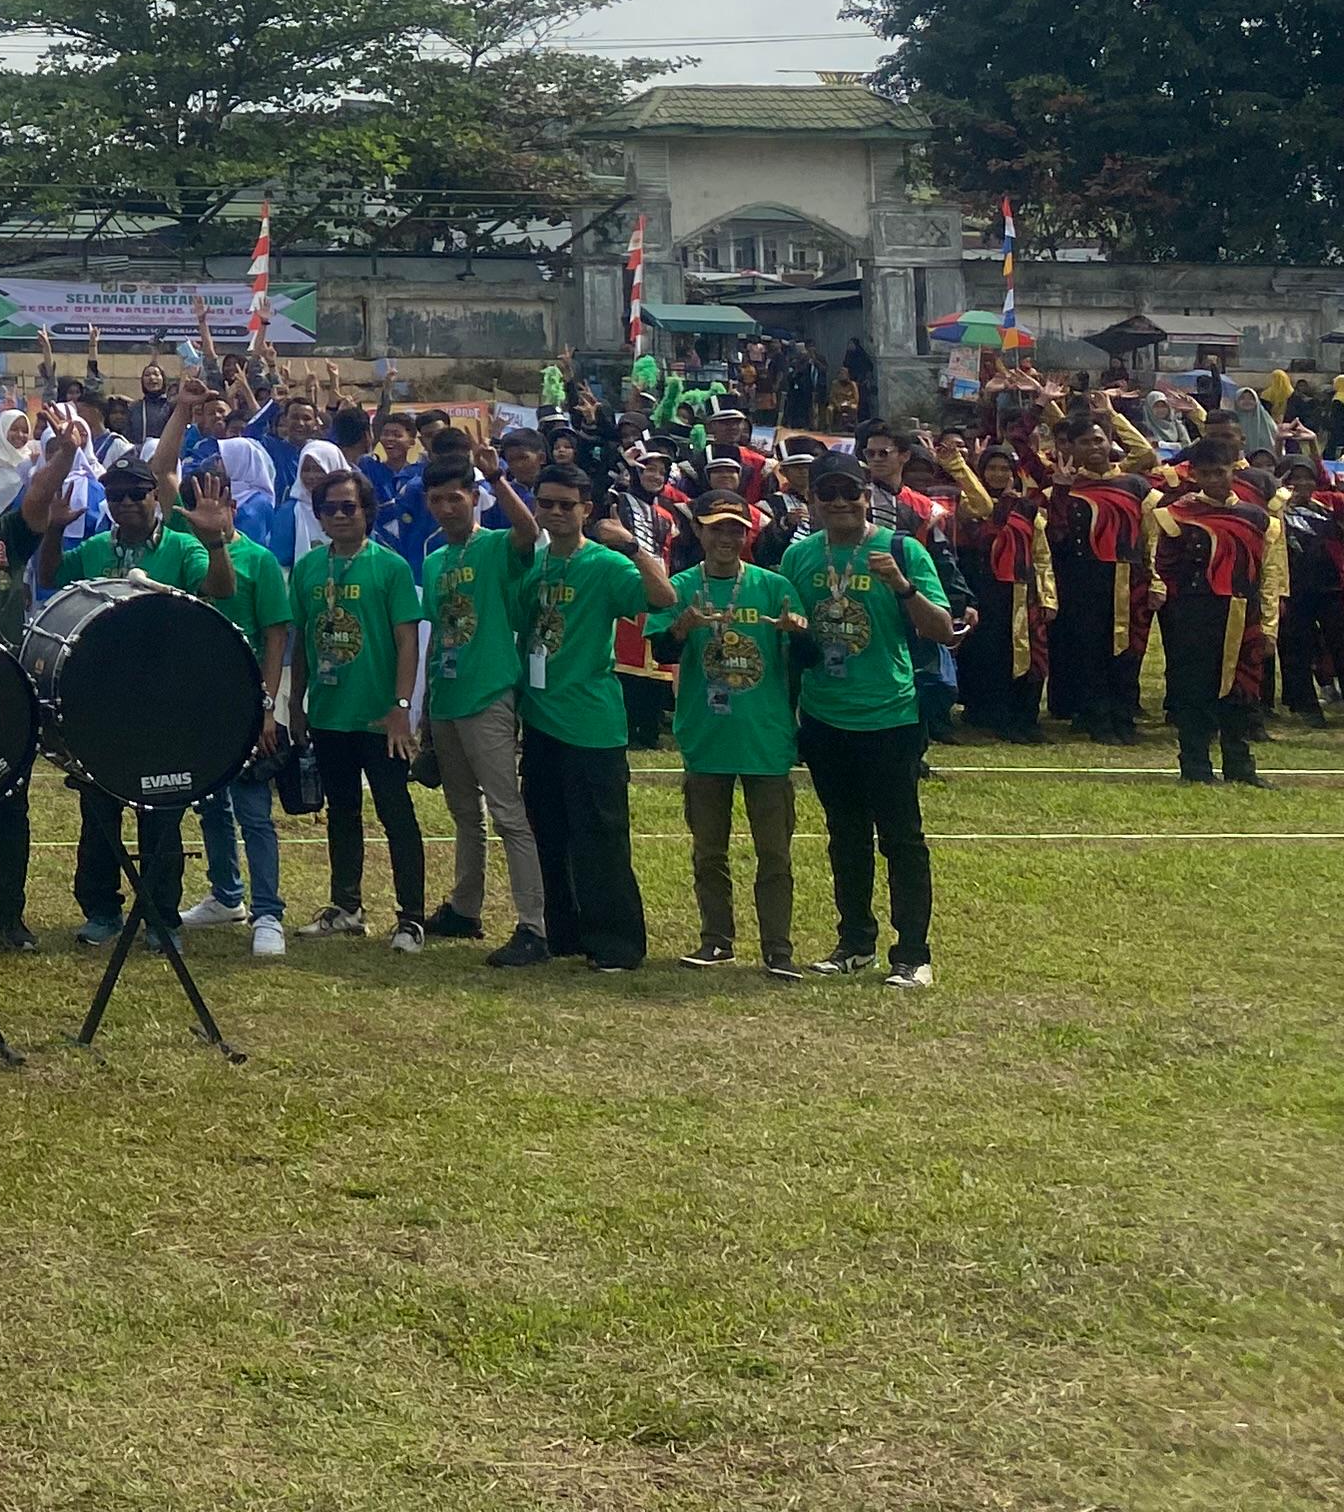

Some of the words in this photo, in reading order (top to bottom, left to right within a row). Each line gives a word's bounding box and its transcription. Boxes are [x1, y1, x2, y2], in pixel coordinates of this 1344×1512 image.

[66, 294, 136, 304] SELAMAT
[313, 584, 360, 600] SMB
[141, 772, 192, 788] EVANS
